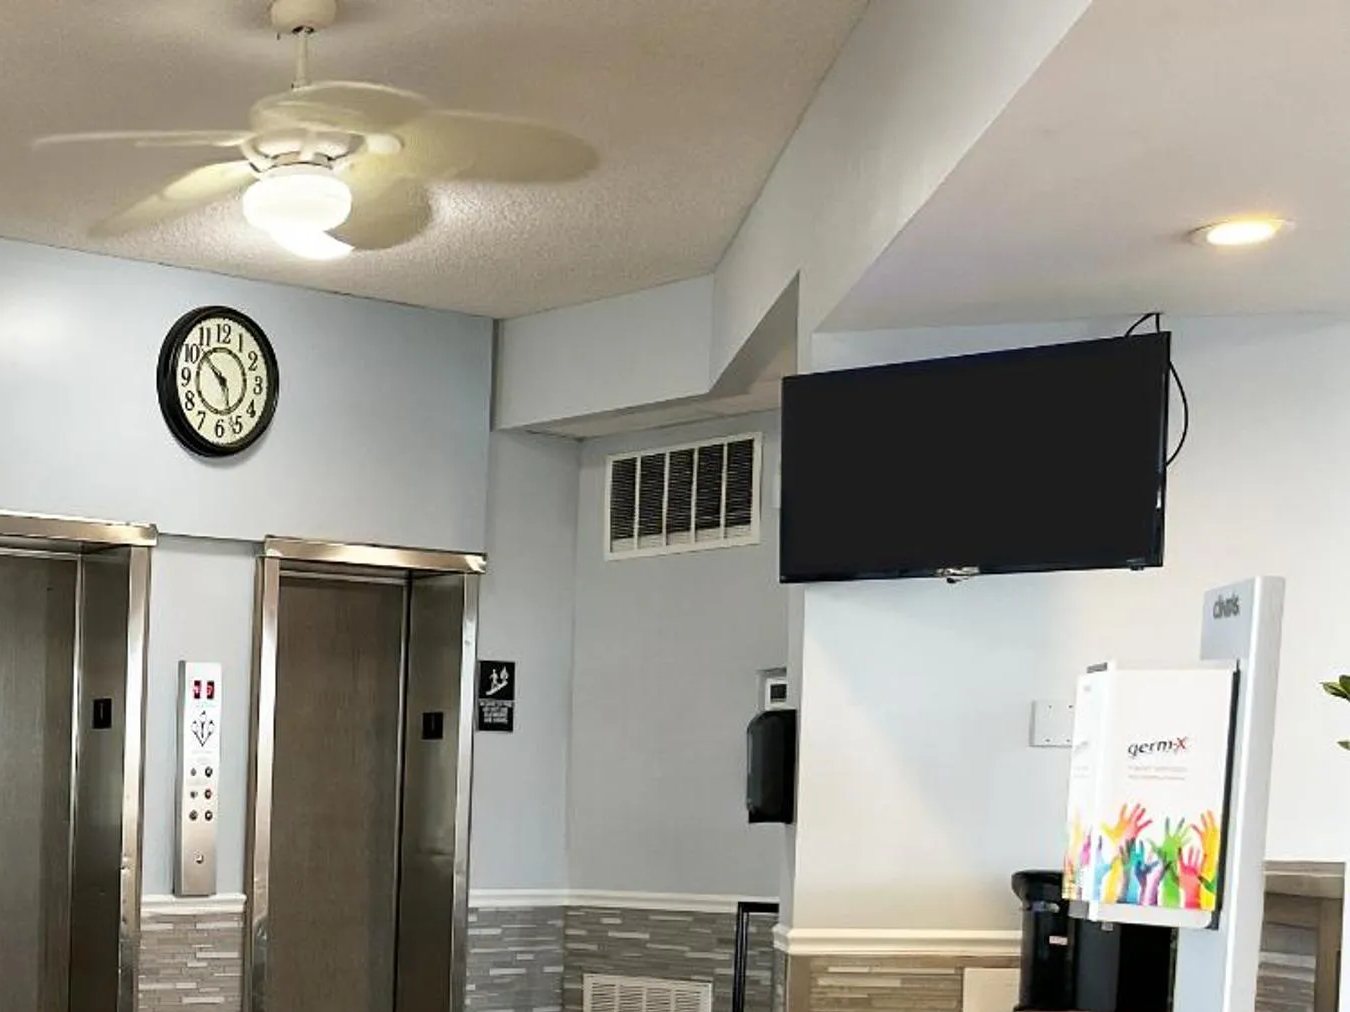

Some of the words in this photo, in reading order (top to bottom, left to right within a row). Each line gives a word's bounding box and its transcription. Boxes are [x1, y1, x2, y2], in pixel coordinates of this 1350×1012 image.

[199, 327, 211, 347] 11
[216, 324, 232, 344] 12
[238, 333, 243, 352] 1
[184, 343, 200, 364] 10
[248, 351, 258, 371] 2
[181, 367, 191, 387] 9
[253, 376, 263, 395] 3
[185, 390, 195, 411] 8
[246, 399, 256, 418] 4
[197, 411, 206, 430] 7
[214, 419, 225, 438] 6
[232, 416, 243, 434] 5
